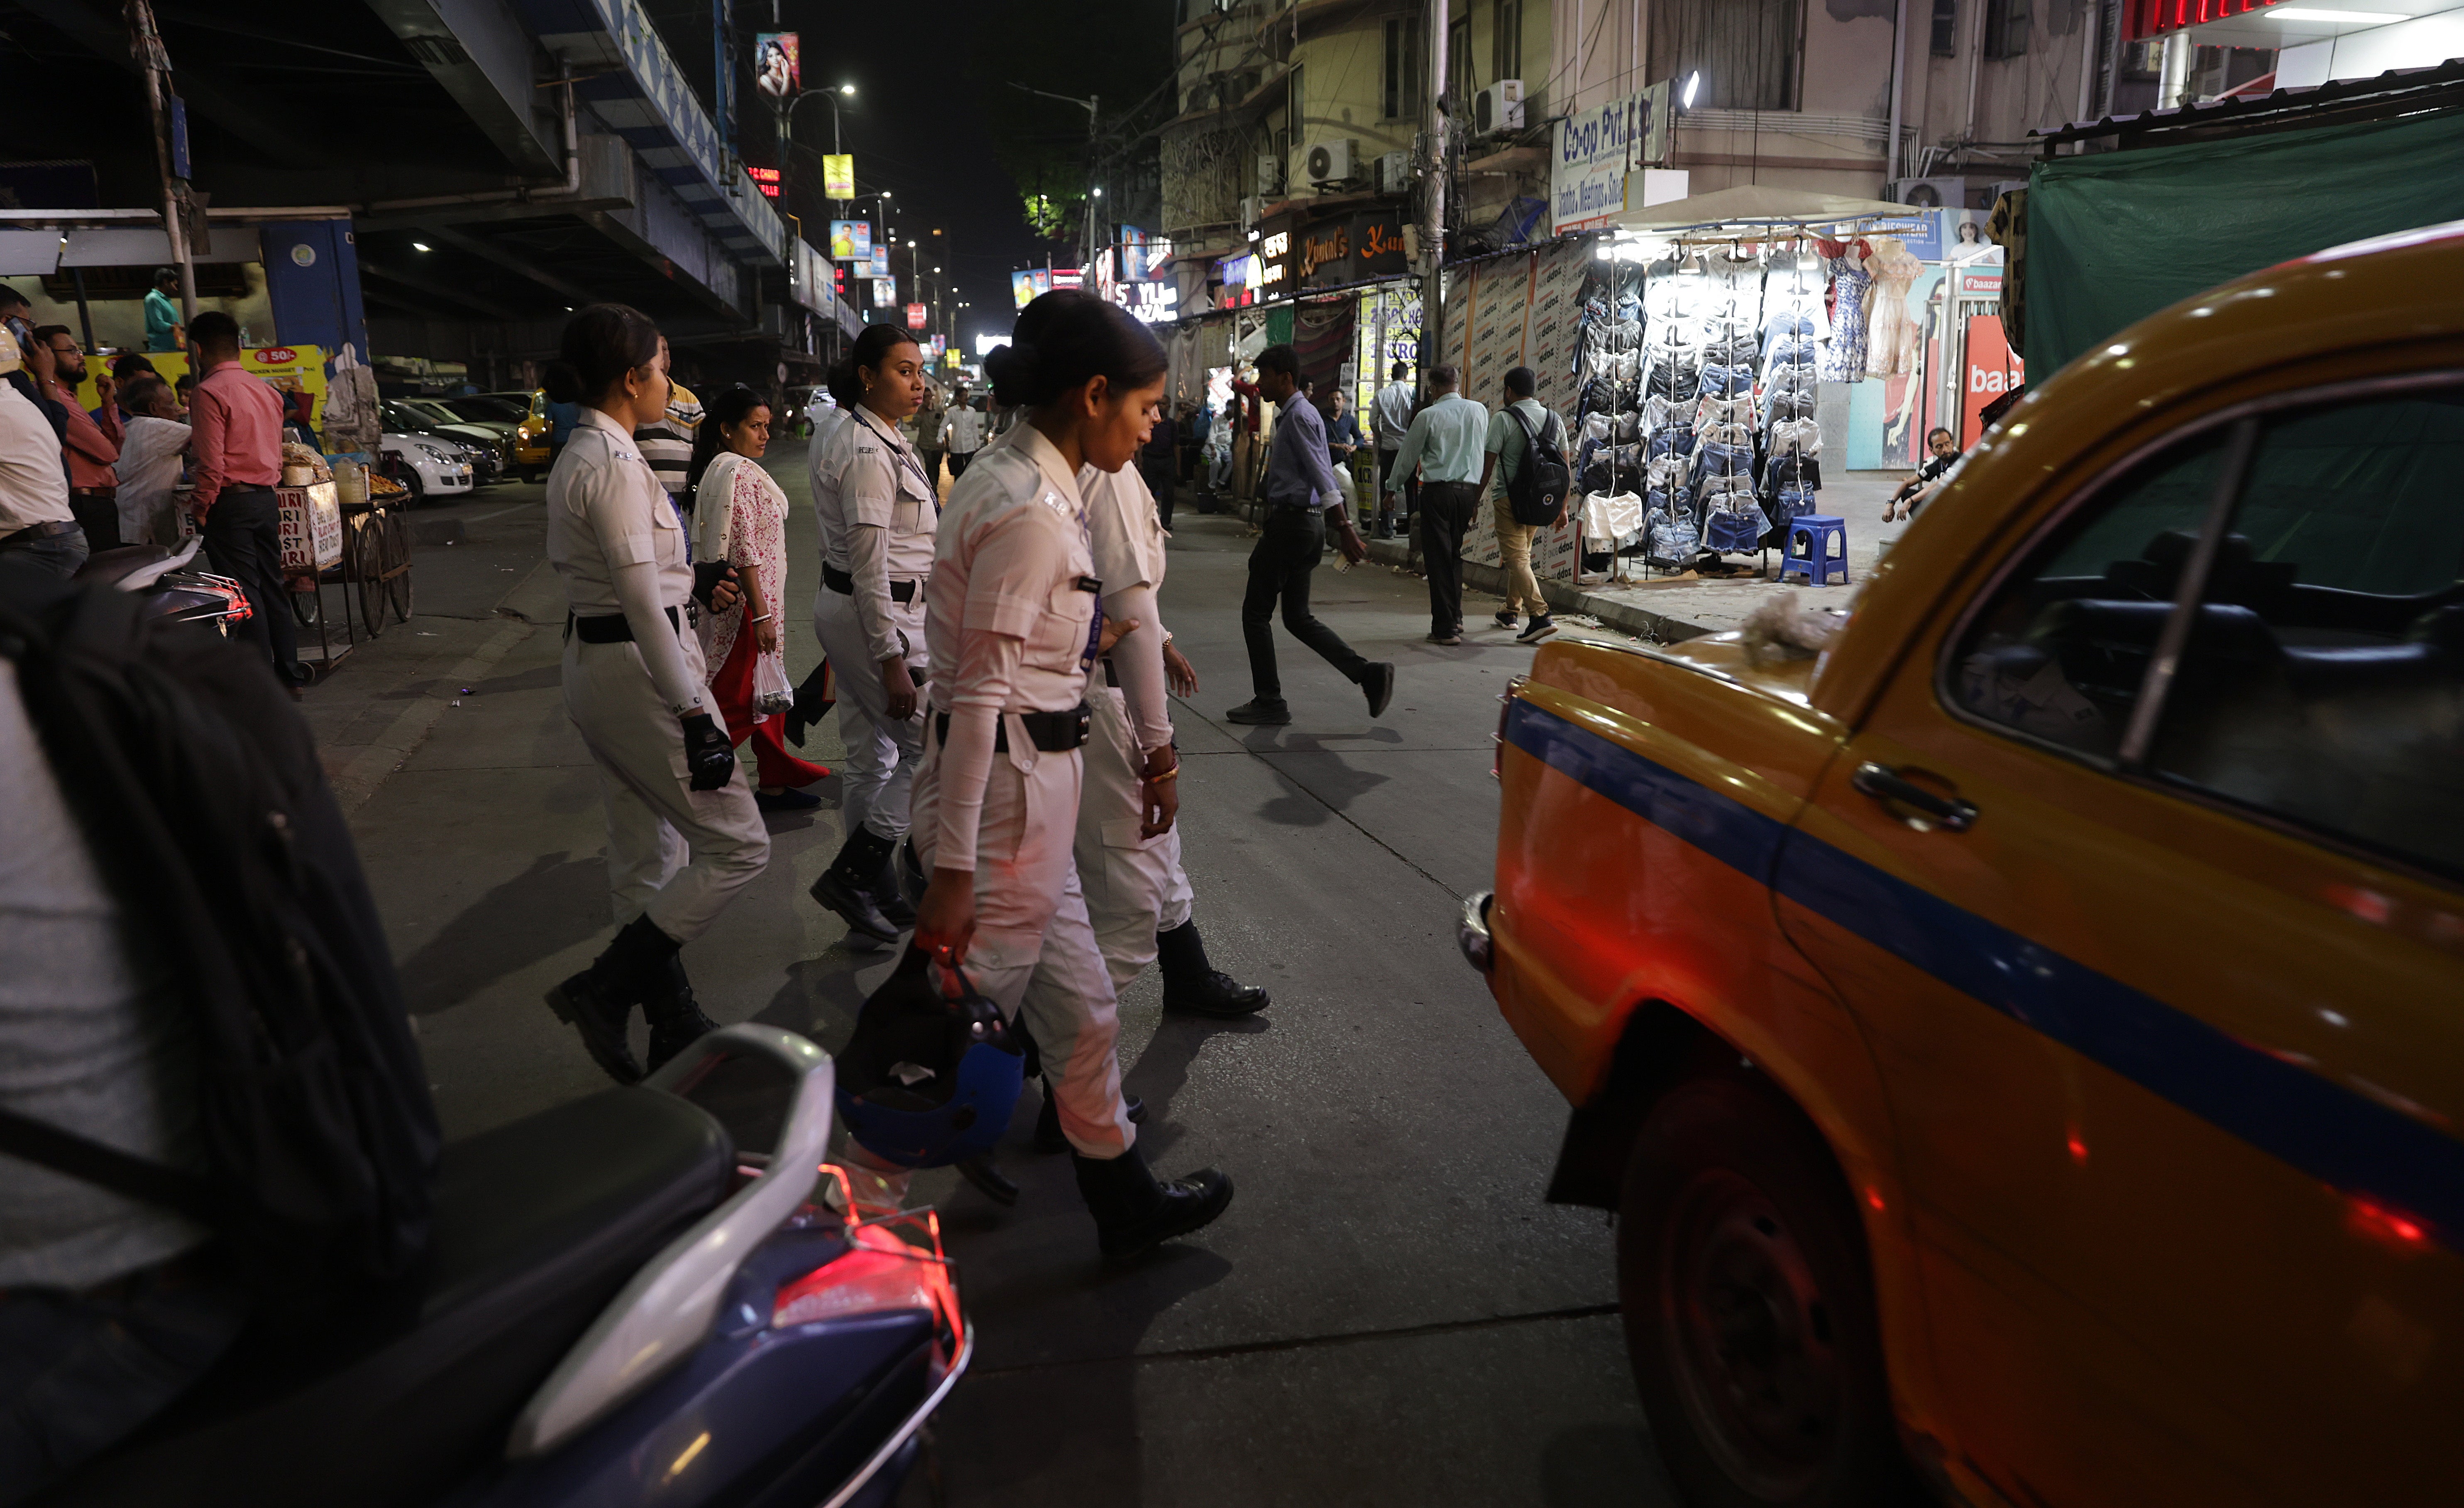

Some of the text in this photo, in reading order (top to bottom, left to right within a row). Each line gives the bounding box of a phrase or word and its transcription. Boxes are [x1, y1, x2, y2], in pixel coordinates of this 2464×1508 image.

[1564, 116, 1597, 164] Co-op
[1601, 101, 1626, 150] Pvt.
[1608, 171, 1624, 206] Socia
[1361, 223, 1406, 259] Kun
[1547, 265, 1562, 283] zapp
[1544, 295, 1559, 311] zapp
[1542, 321, 1557, 337] zapp
[1540, 347, 1554, 363] zapp
[1538, 376, 1552, 391] zapp
[1970, 364, 2021, 393] baa
[277, 492, 301, 508] URI
[280, 509, 301, 522] RI
[278, 523, 298, 536] RI
[283, 536, 303, 550] ST
[1532, 535, 1542, 546] zap
[1558, 541, 1573, 554] zapp
[1557, 567, 1572, 580] zapp
